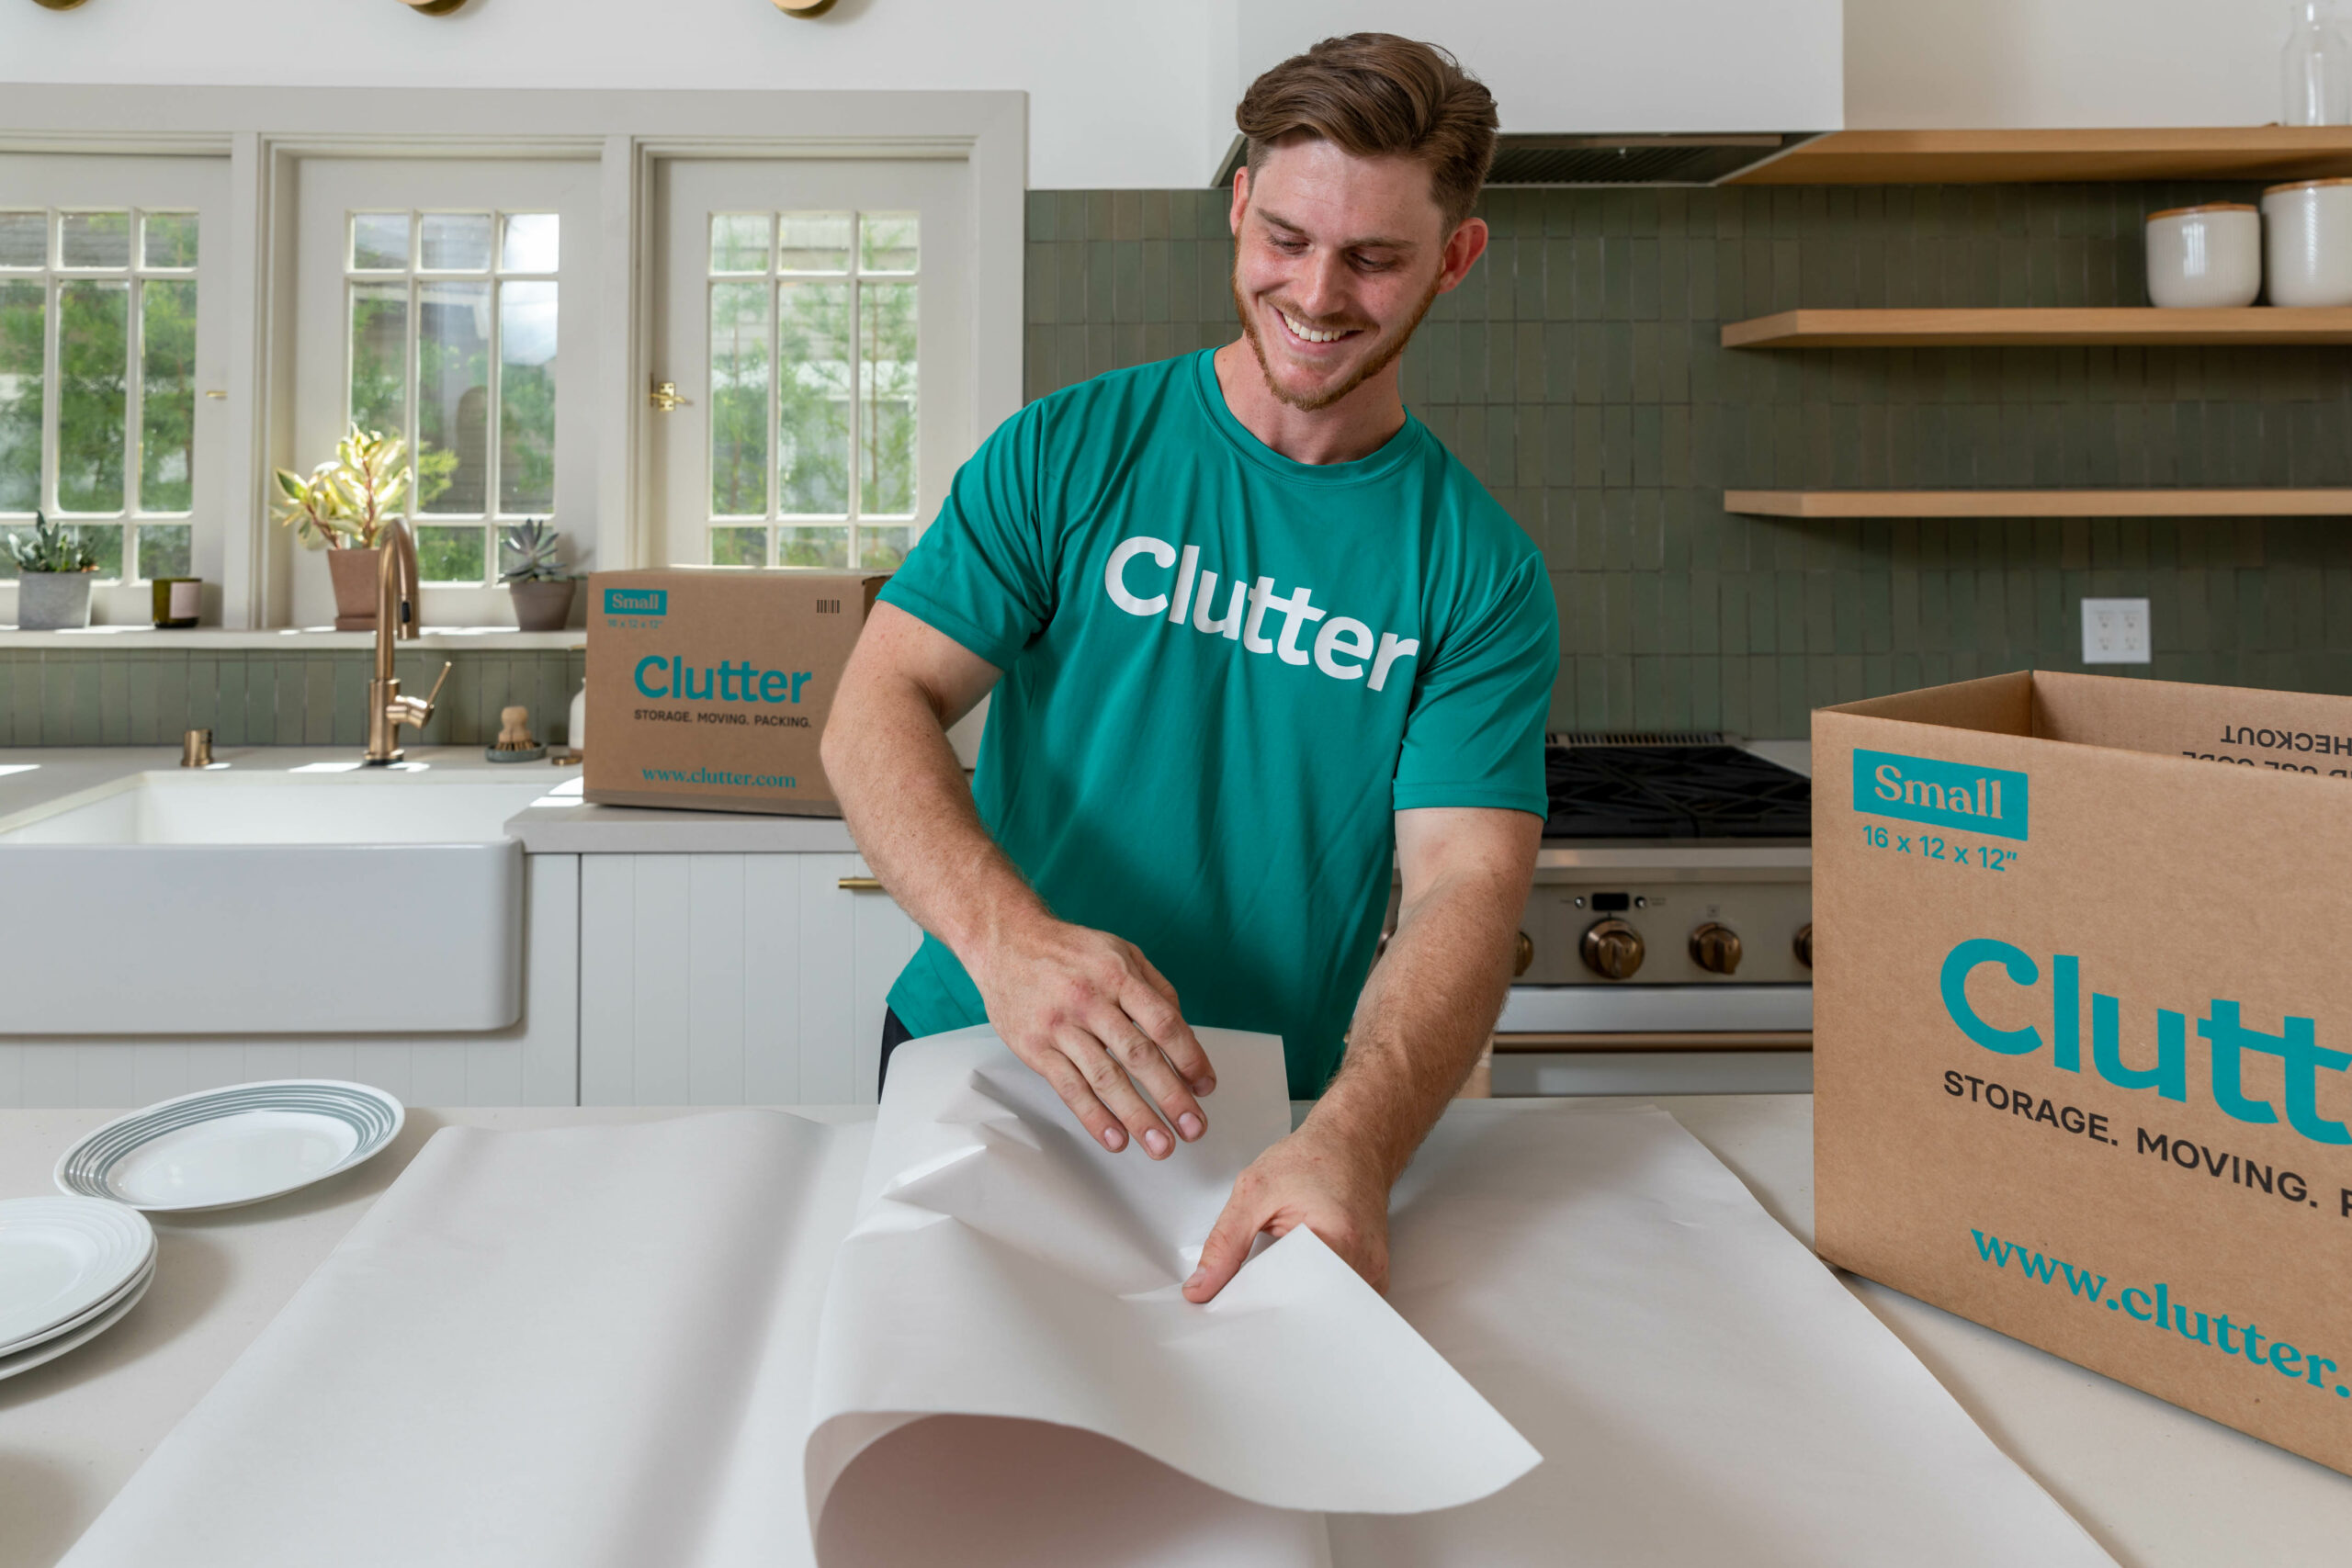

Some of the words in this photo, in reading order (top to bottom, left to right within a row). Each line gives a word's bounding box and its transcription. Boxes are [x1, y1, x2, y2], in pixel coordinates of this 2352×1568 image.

[612, 592, 659, 610] Small
[1104, 536, 1419, 692] Clutter
[634, 655, 812, 704] Clutter
[634, 708, 693, 724] STORAGE.
[697, 712, 750, 726] MOVING.
[754, 715, 812, 728] PACKING.
[642, 767, 797, 788] www.clutter.com
[1873, 763, 2004, 820] Small
[1862, 825, 1889, 849] 16
[1896, 835, 1911, 854] x
[1918, 835, 1945, 861] 12
[1953, 846, 1969, 865] x
[1943, 1069, 2118, 1147] STORAGE.
[2137, 1127, 2317, 1209] MOVING.
[1970, 1228, 2351, 1399] www.clutter.
